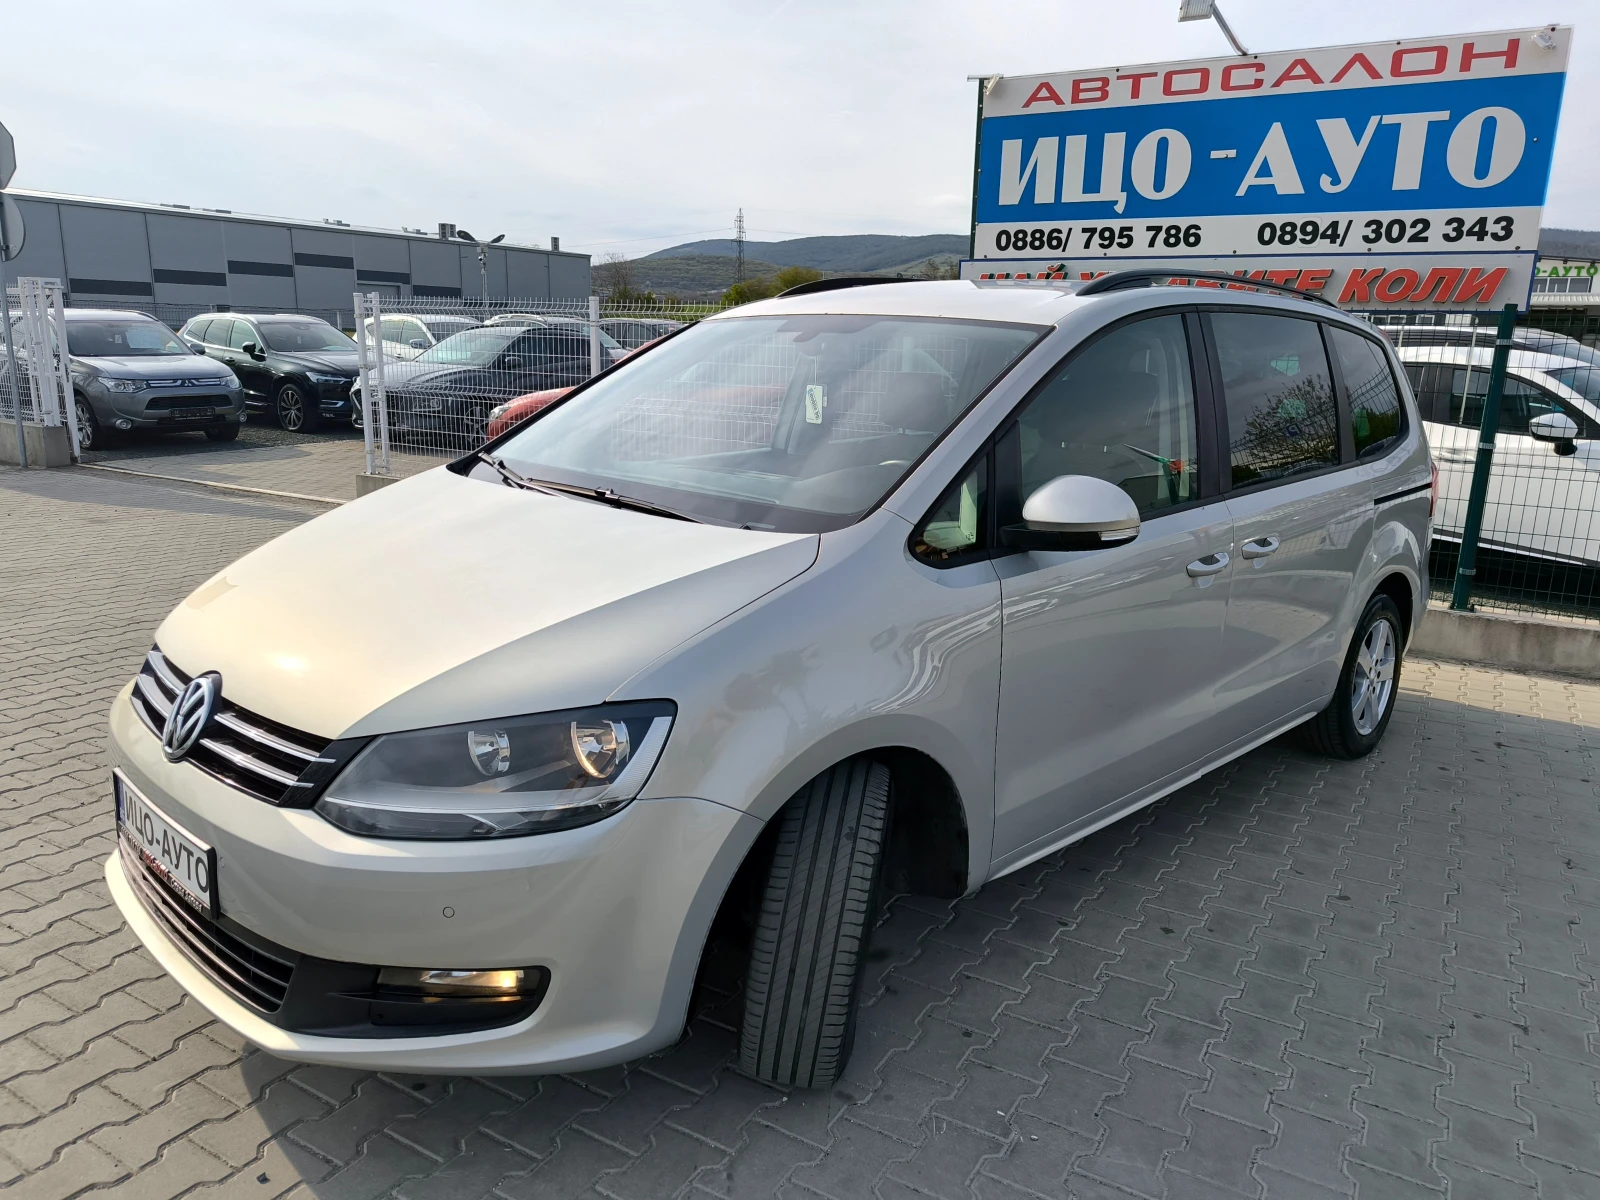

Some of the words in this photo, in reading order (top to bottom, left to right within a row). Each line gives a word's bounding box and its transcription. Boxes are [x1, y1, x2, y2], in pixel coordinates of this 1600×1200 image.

[1021, 38, 1521, 109] АВТОСАЛОН
[994, 227, 1073, 253] 0886/
[1080, 226, 1134, 250] 795
[1145, 224, 1202, 249] 786
[1256, 219, 1353, 248] 0894/
[1361, 217, 1430, 244] 302
[1442, 215, 1515, 242] 343
[1338, 267, 1509, 304] КОЛИ
[124, 789, 210, 894] ИЦО-АУТО
